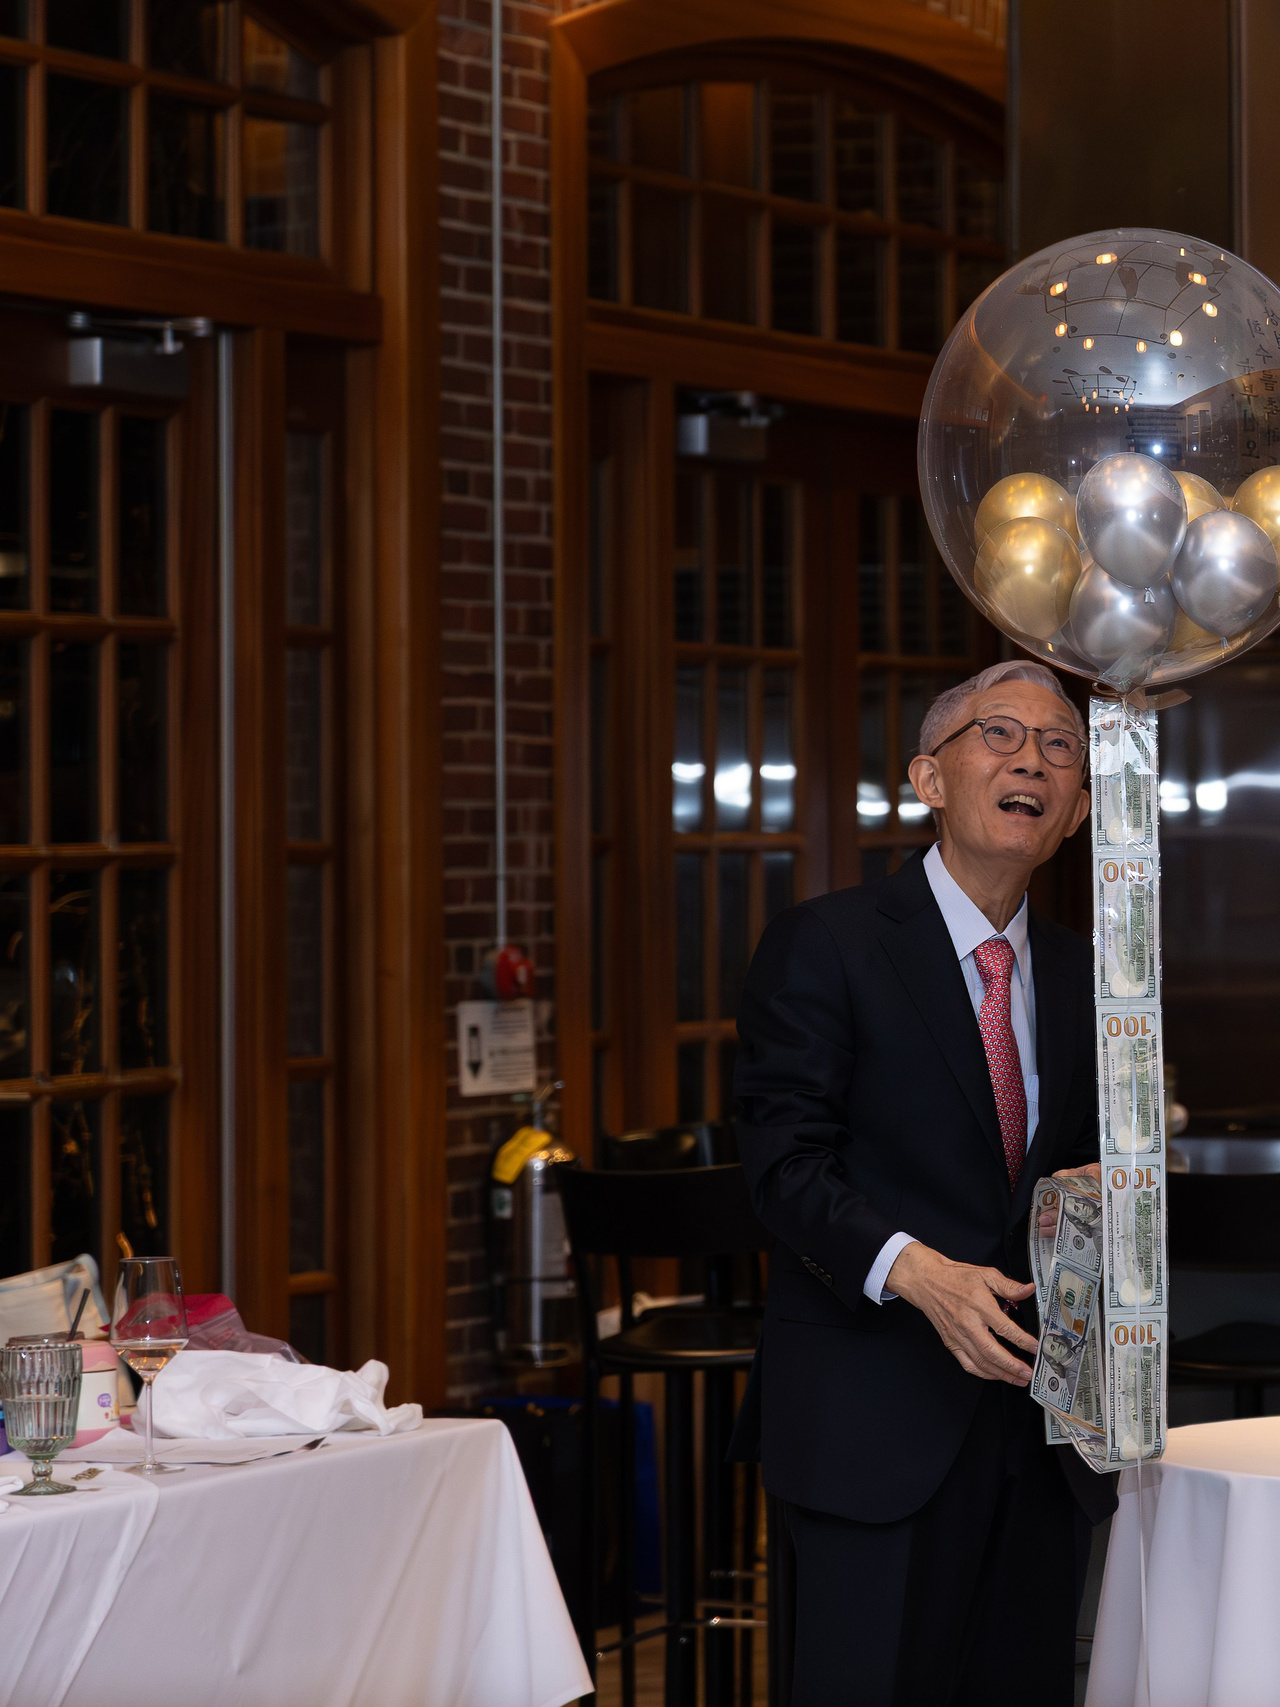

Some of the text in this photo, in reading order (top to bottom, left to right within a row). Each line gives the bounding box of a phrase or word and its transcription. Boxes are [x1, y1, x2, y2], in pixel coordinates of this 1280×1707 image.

[1103, 861, 1148, 884] 100
[1107, 1016, 1152, 1038] 100
[1111, 1168, 1156, 1190] 100
[1114, 1324, 1156, 1346] 100
